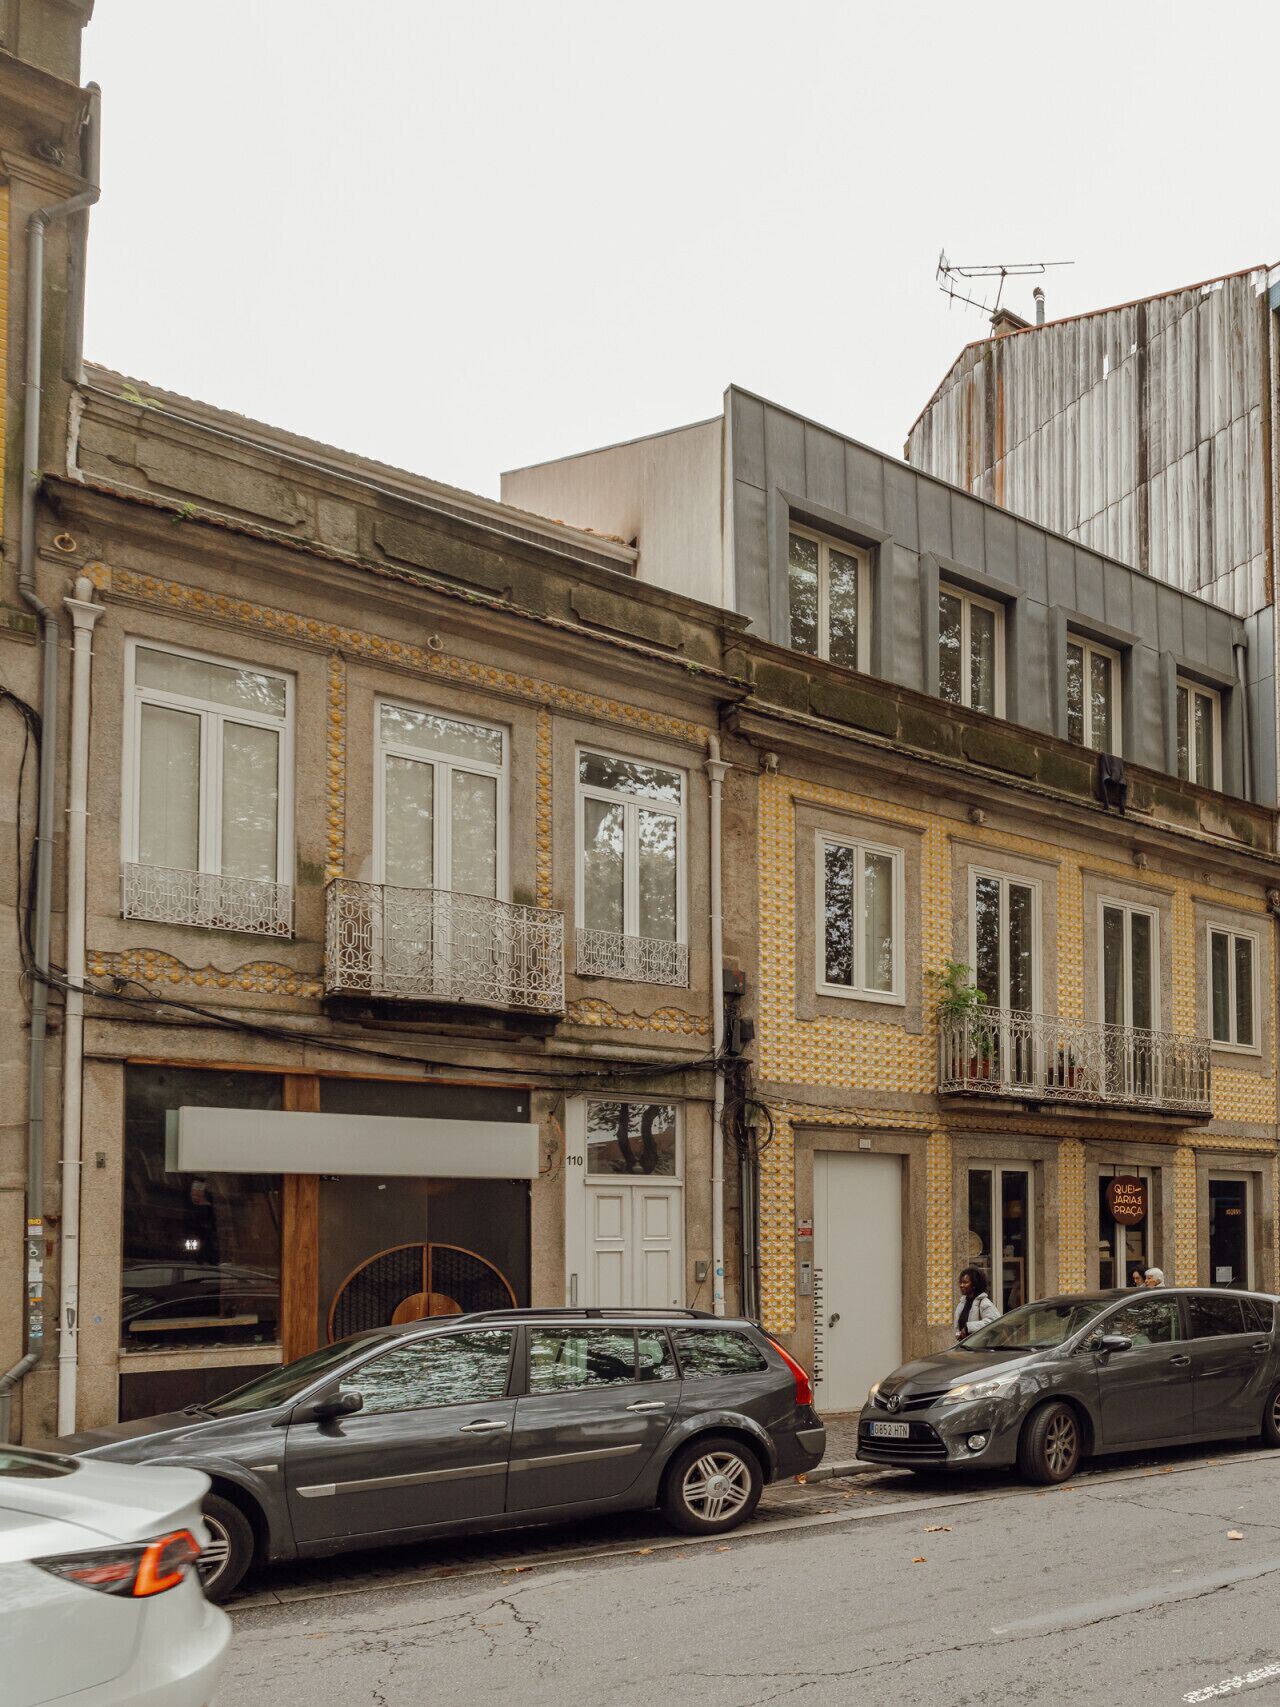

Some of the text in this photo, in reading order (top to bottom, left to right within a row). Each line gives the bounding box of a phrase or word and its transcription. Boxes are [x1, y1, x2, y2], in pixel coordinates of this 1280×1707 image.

[566, 1155, 583, 1166] 110
[1113, 1195, 1137, 1204] JARIA
[1113, 1205, 1143, 1216] PRAÇA
[895, 1425, 908, 1436] HTN
